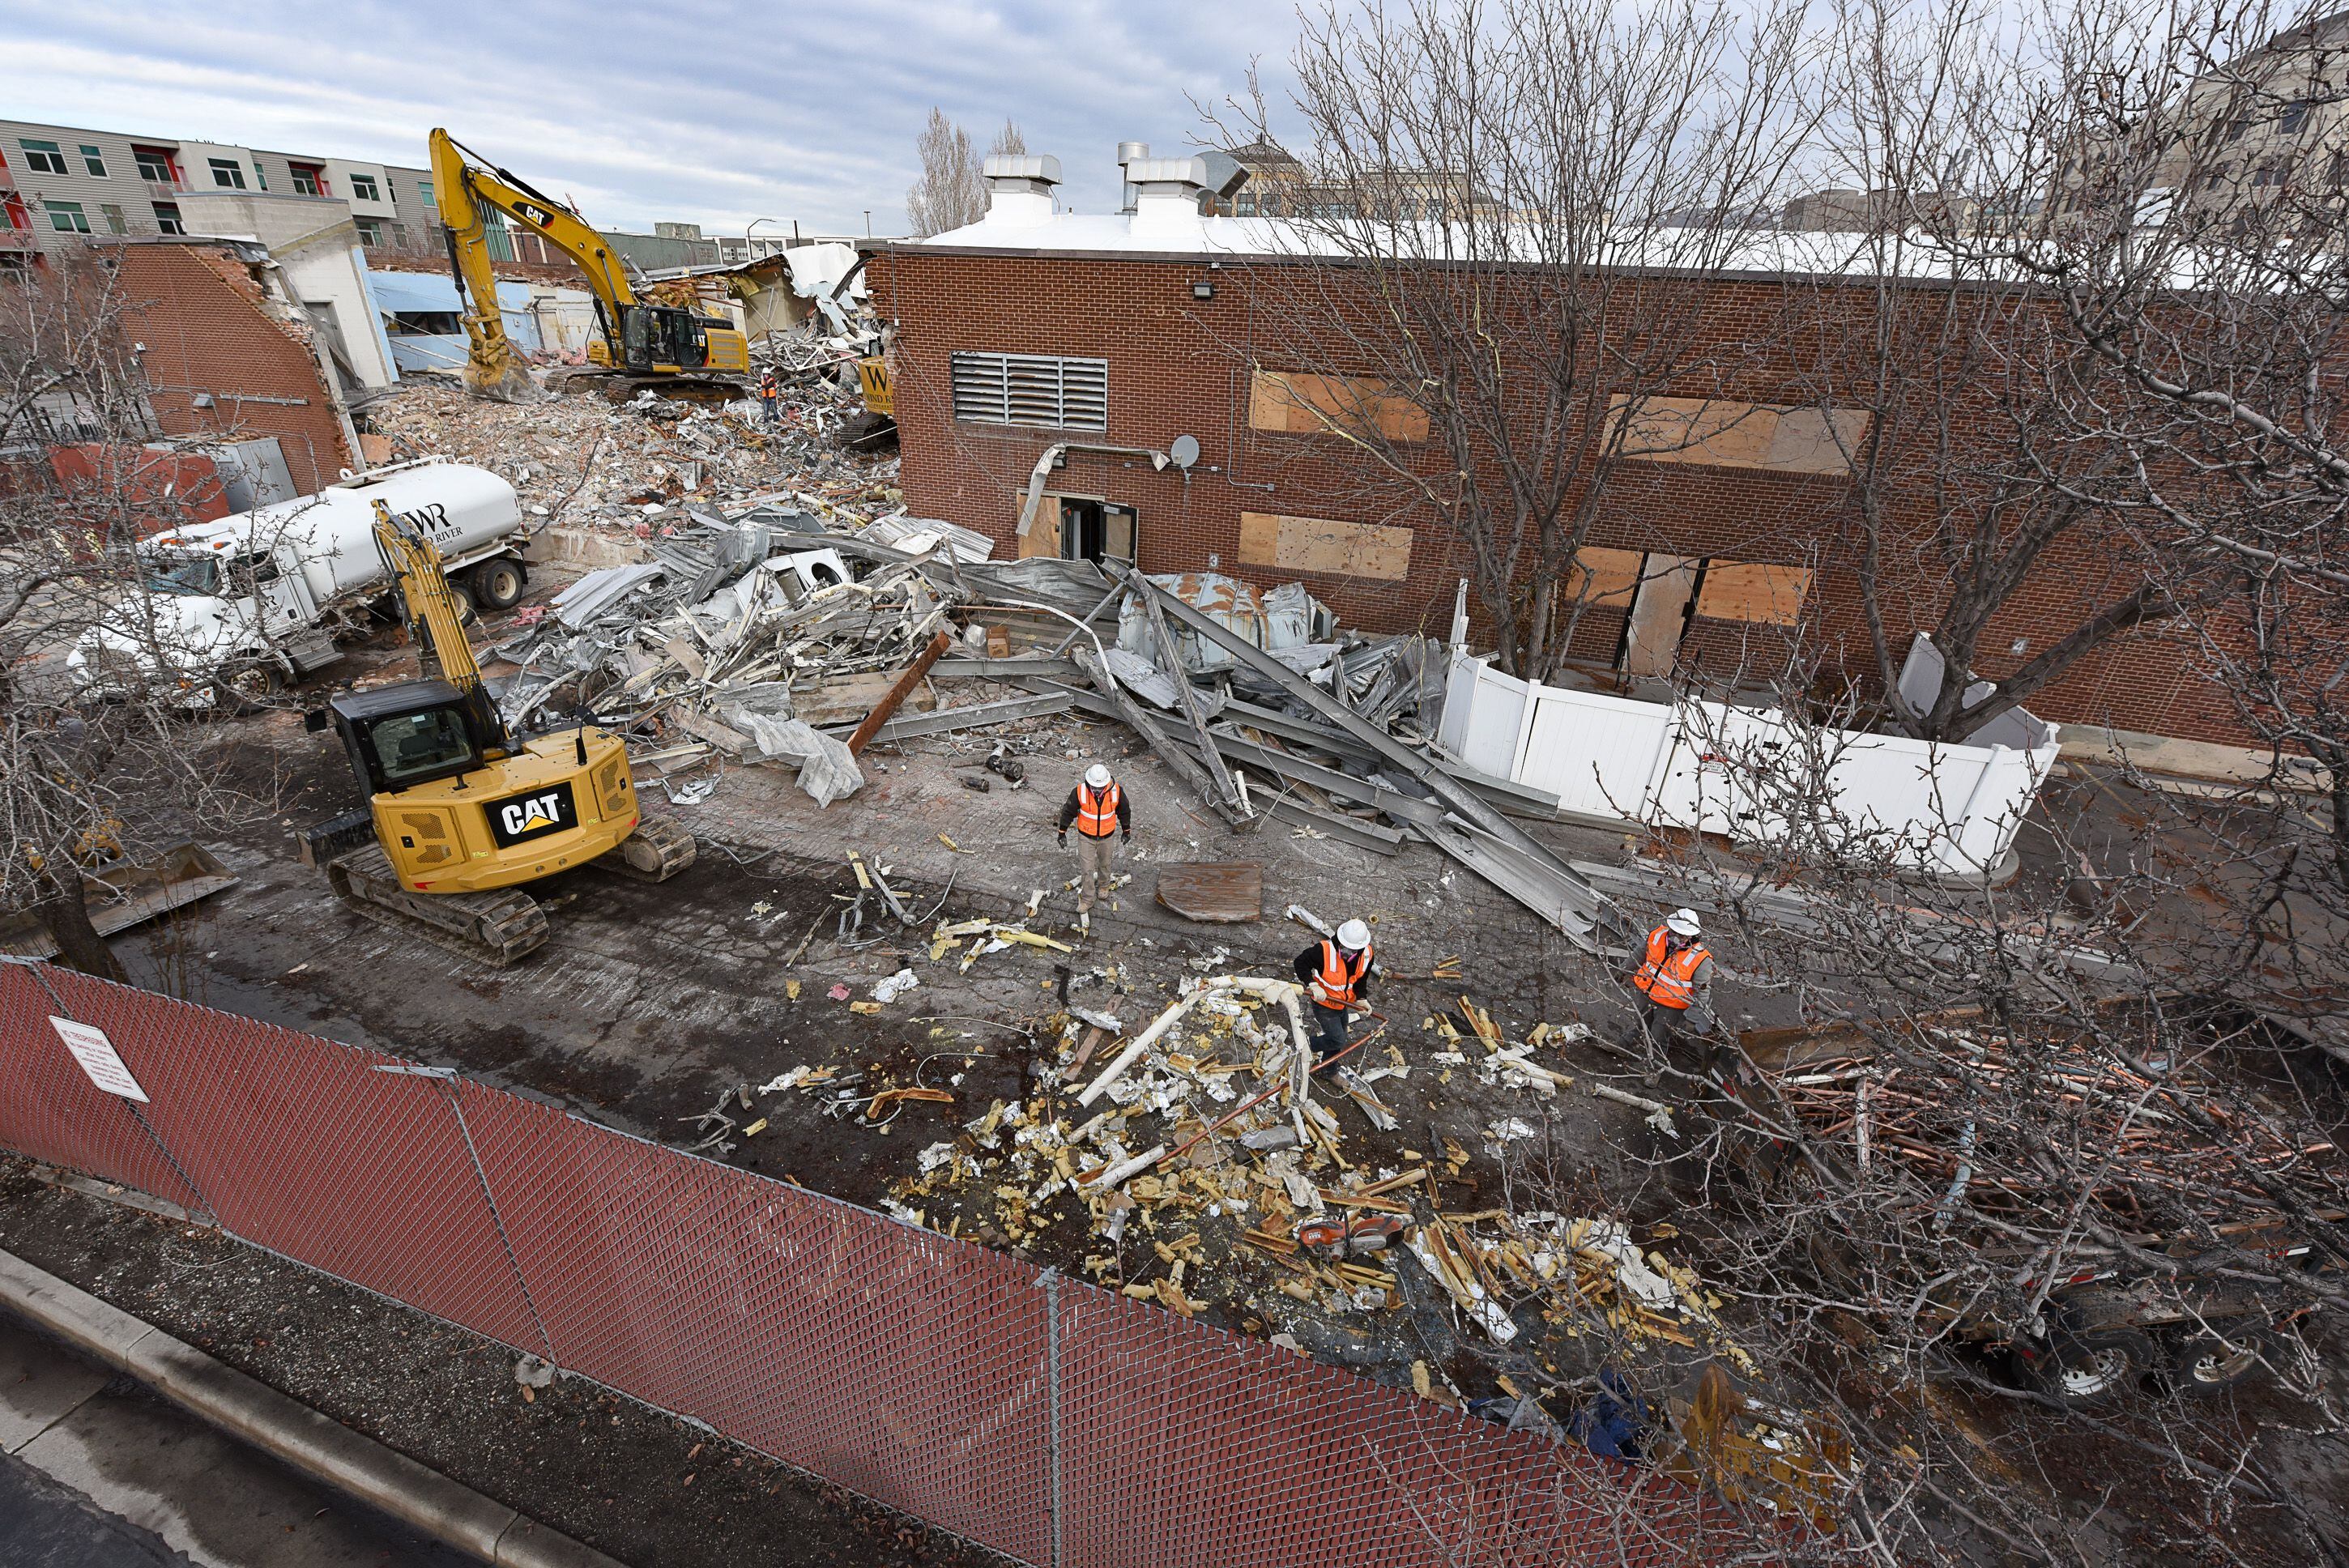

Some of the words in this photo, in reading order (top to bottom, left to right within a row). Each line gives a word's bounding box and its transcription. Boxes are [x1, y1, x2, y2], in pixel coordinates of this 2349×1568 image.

[526, 205, 544, 225] CAT
[692, 334, 706, 347] CAT
[865, 366, 892, 392] W
[402, 503, 451, 535] WR
[435, 526, 463, 543] RIVER
[438, 539, 453, 548] ATION
[1210, 555, 1217, 567] 3
[2013, 640, 2026, 654] 4
[501, 793, 560, 835] CAT
